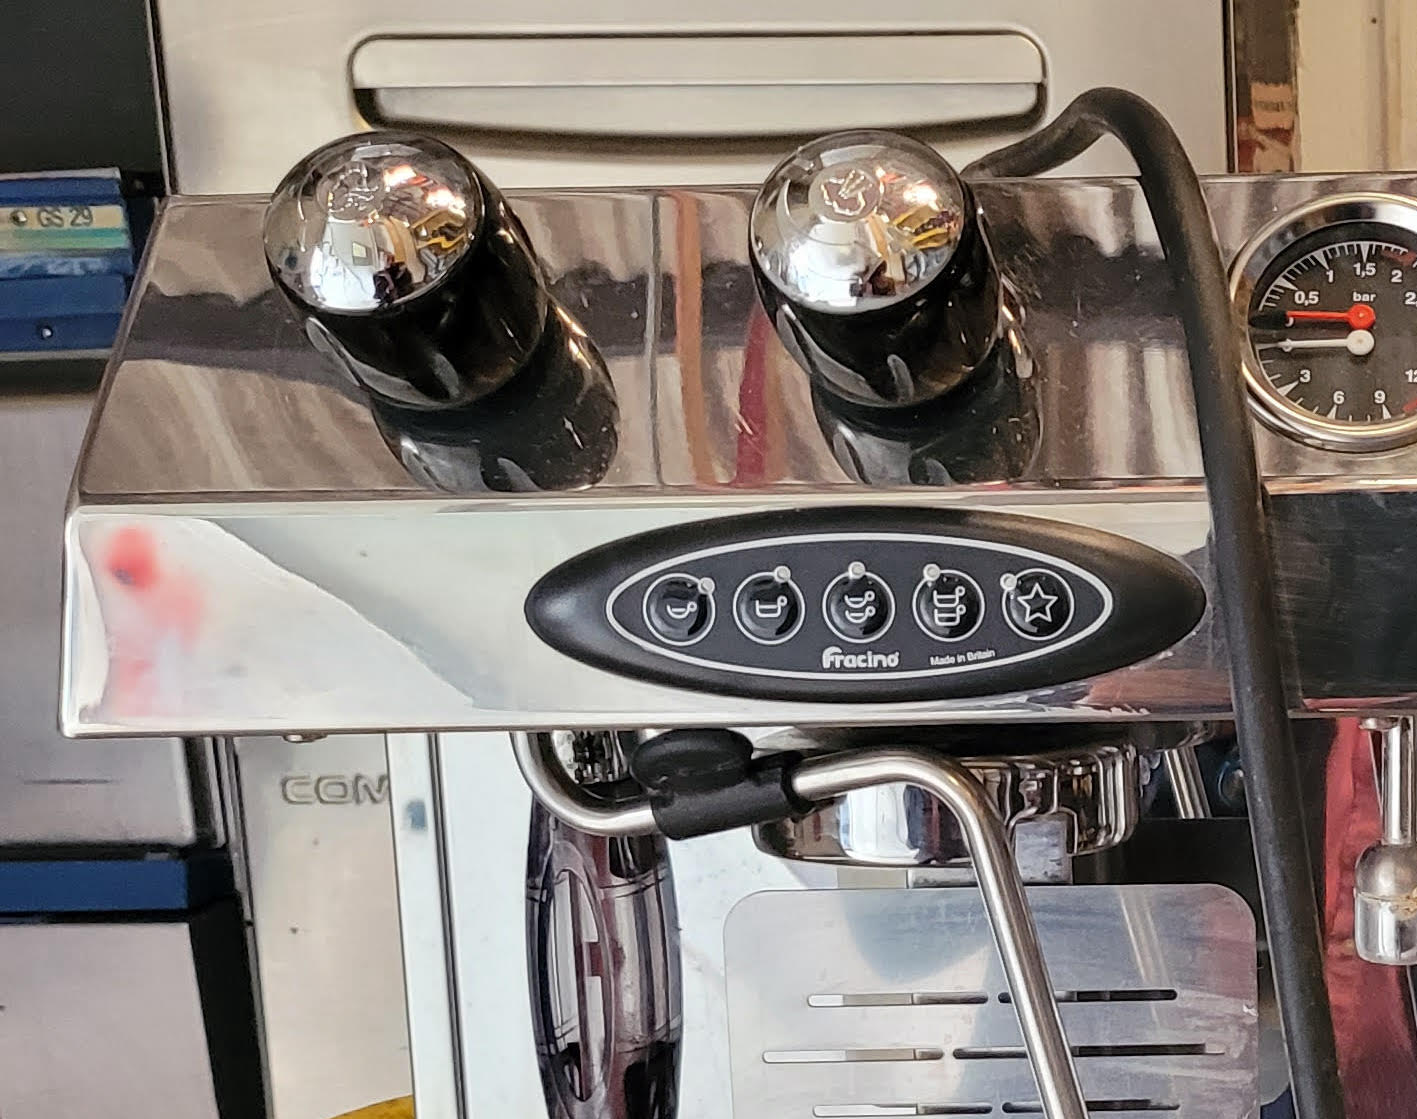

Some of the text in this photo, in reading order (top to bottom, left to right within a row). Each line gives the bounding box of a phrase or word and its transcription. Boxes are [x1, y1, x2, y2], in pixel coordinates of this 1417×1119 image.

[1326, 270, 1334, 283] 1
[1353, 263, 1376, 278] 1,5
[1391, 270, 1402, 283] 2
[1294, 291, 1319, 305] 0,5
[1352, 291, 1376, 302] bar
[1299, 369, 1311, 383] 3
[1333, 390, 1345, 404] 6
[1374, 390, 1386, 404] 9
[930, 649, 996, 666] Made in Britain
